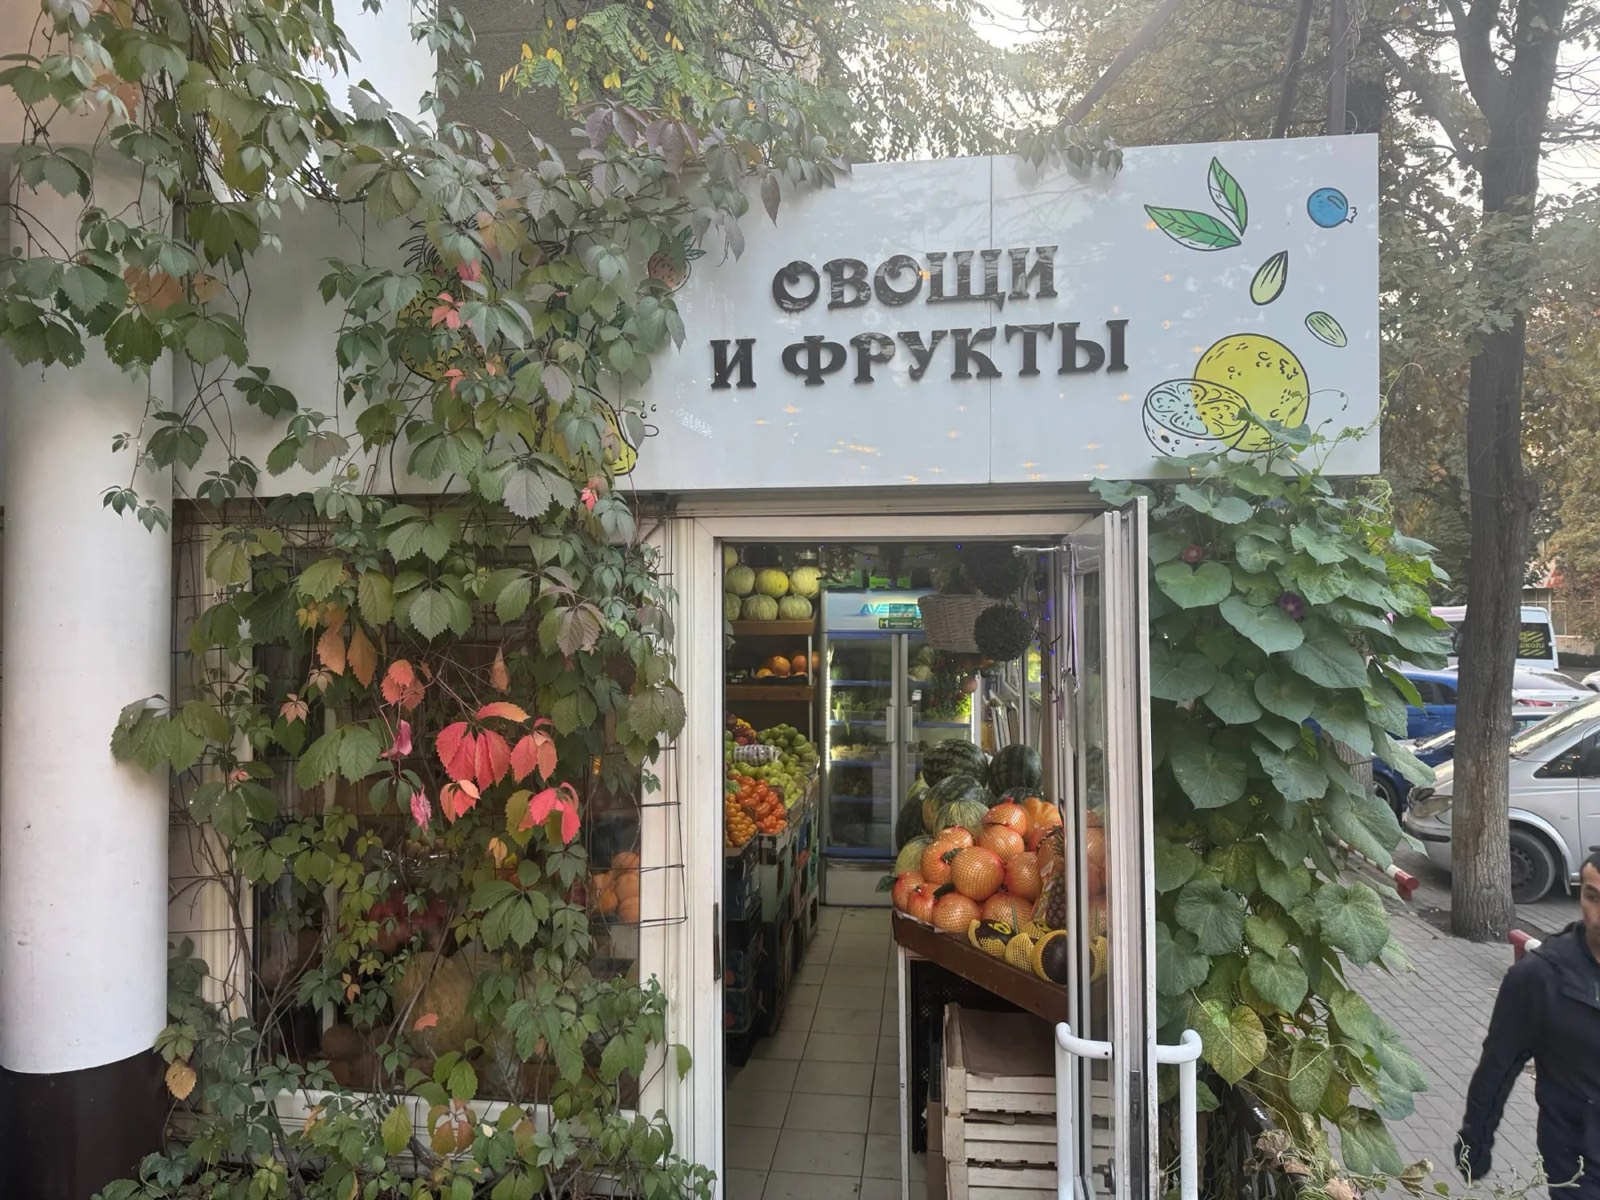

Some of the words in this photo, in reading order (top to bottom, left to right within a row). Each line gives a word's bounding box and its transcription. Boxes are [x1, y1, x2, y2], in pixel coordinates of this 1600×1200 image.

[772, 245, 1059, 311] ОВОЩИ
[710, 338, 757, 389] И
[781, 319, 1130, 386] ФРУКТЫ
[860, 603, 889, 616] AVE
